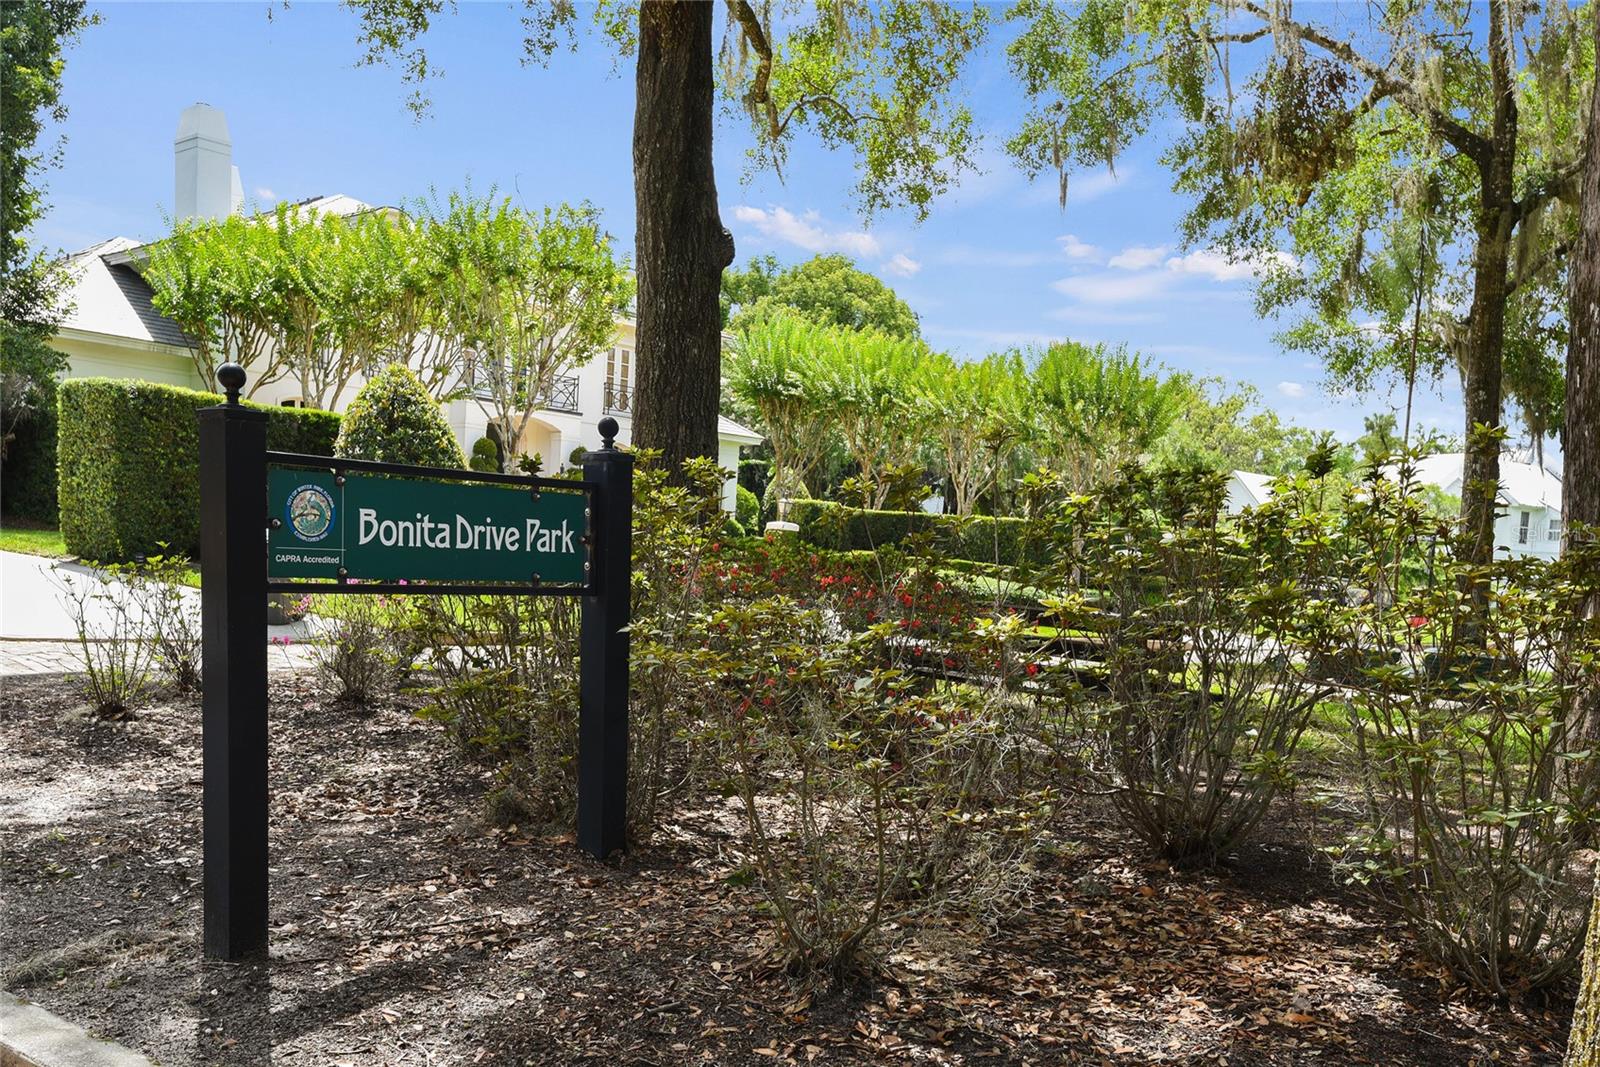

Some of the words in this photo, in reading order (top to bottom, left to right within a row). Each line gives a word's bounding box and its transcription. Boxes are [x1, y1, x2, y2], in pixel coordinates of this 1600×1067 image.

[359, 508, 450, 548] Bonita
[456, 513, 520, 551] Drive
[526, 518, 575, 553] Park
[275, 554, 301, 563] CAPRA
[303, 555, 340, 564] Accredited
